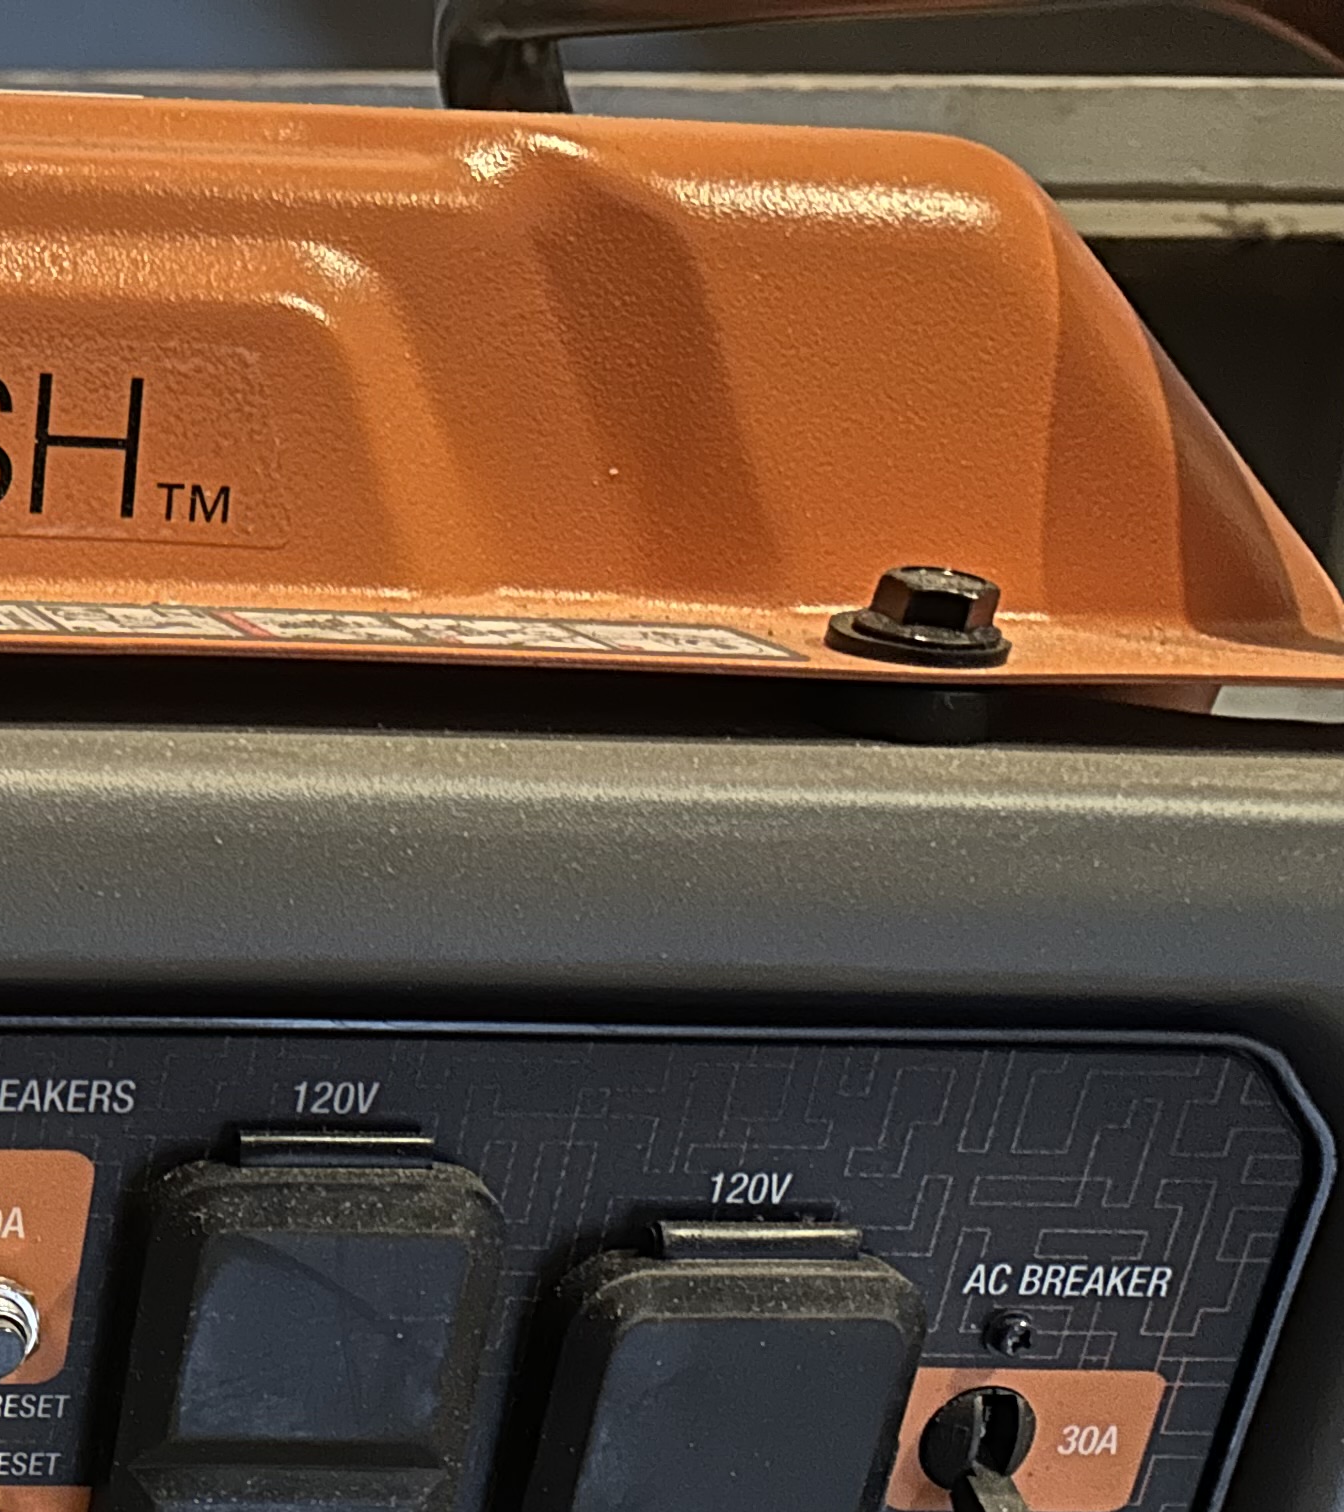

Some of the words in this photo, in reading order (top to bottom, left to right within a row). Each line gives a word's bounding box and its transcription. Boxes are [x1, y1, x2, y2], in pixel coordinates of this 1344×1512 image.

[294, 1081, 380, 1114] 120V
[711, 1172, 793, 1205] 120V
[962, 1263, 1012, 1296] AC
[1018, 1264, 1173, 1298] BREAKER
[1057, 1425, 1118, 1456] 30A
